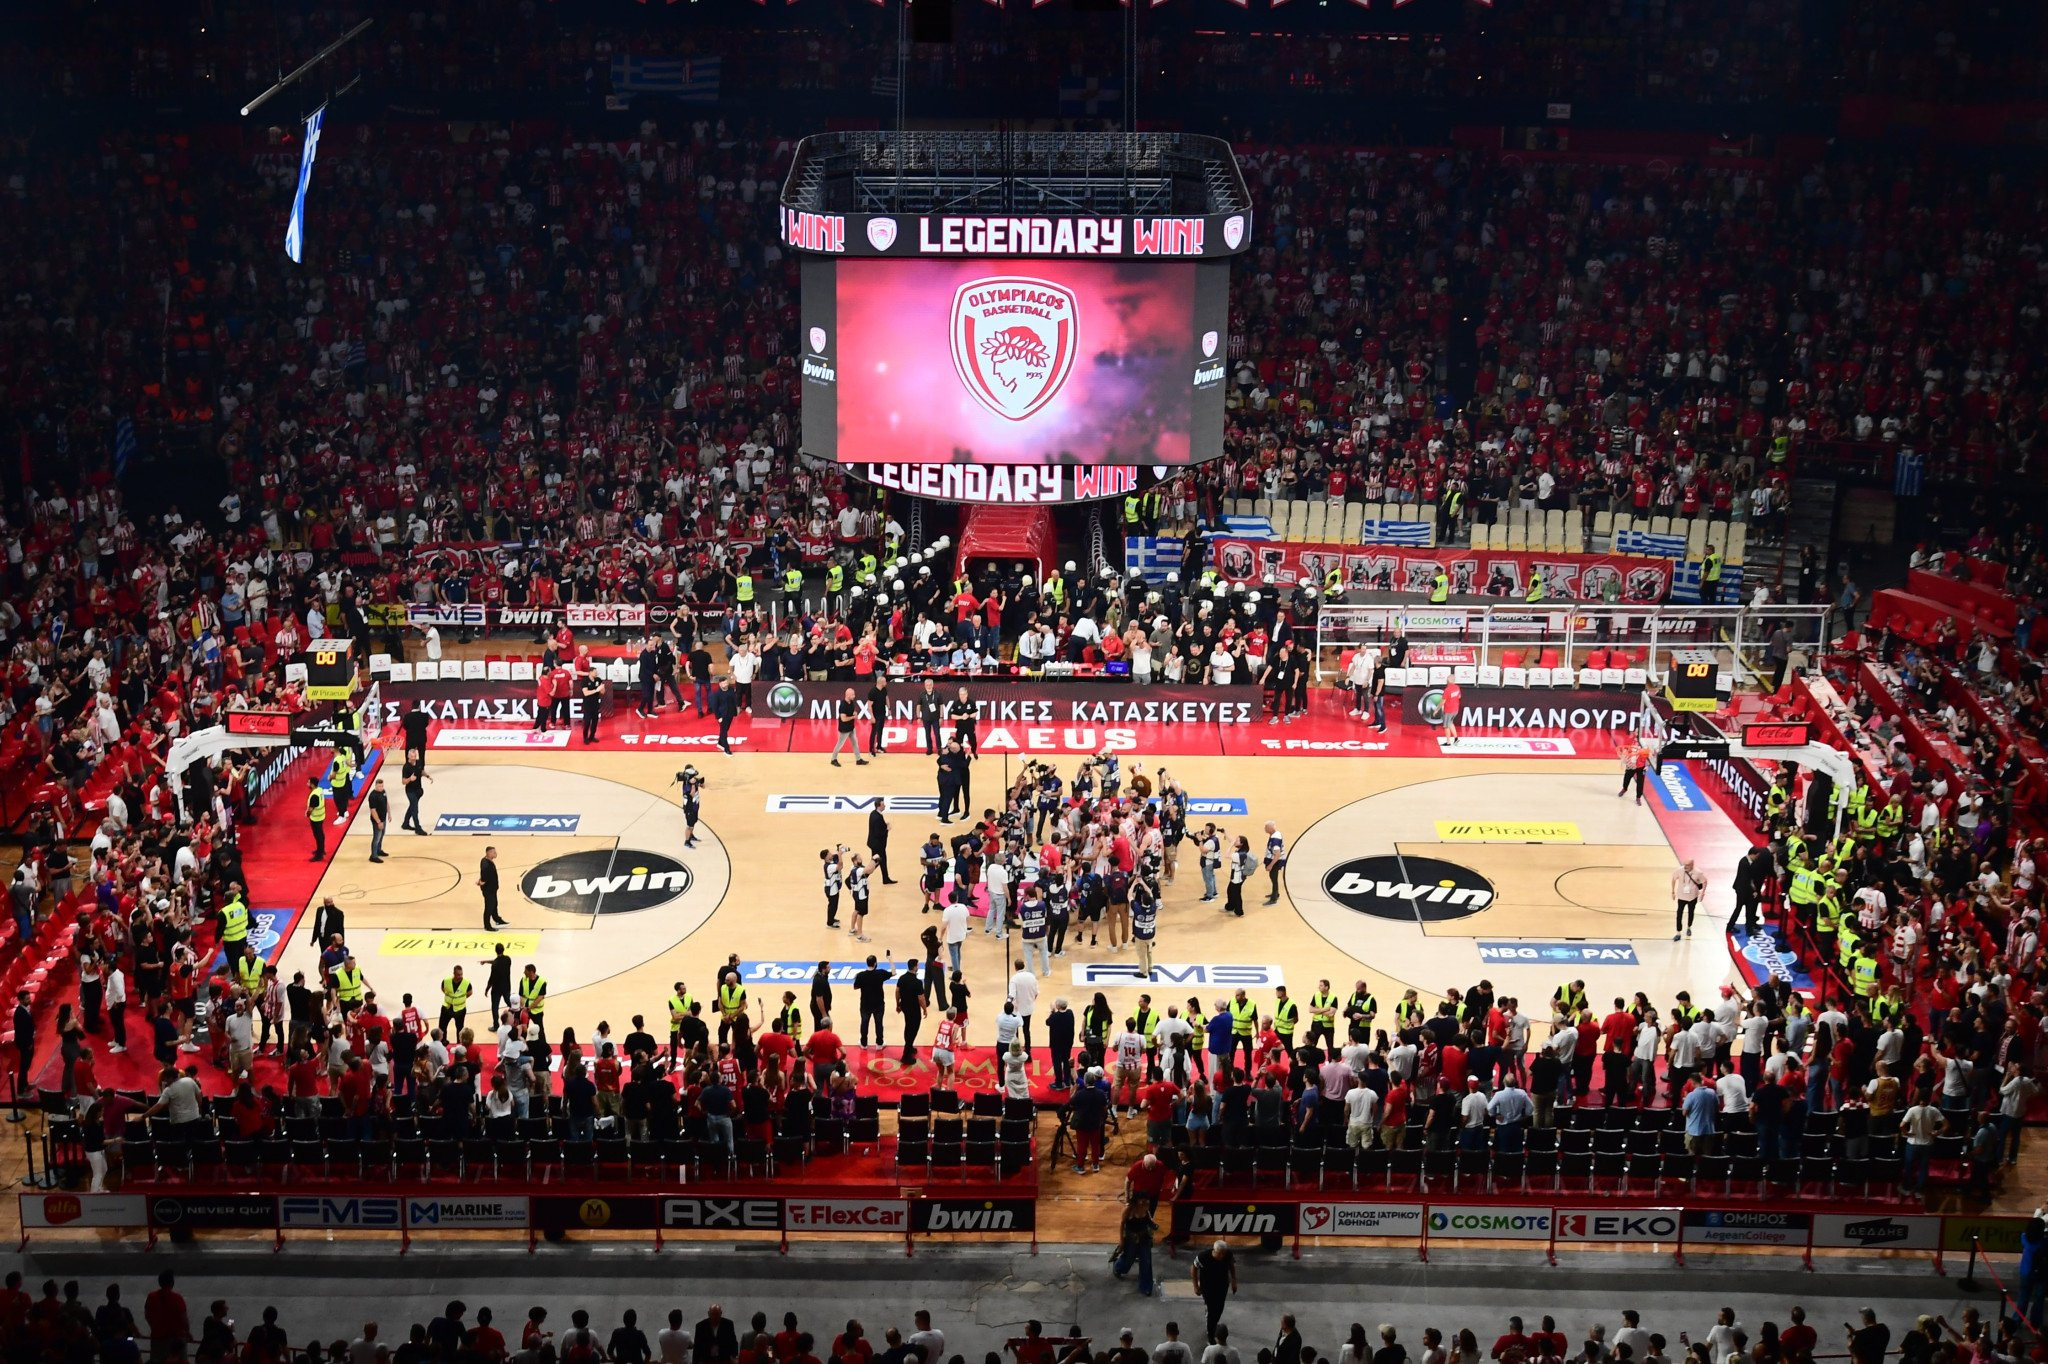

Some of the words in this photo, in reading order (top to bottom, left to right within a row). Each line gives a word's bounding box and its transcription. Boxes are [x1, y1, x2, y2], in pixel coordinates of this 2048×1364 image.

[788, 209, 845, 253] WIN!
[919, 217, 1123, 254] LEGENDARY
[1133, 218, 1205, 255] WIN!
[968, 288, 1066, 311] OLYMPIACOS
[982, 304, 1052, 321] BASKETBALL
[802, 359, 836, 382] bwin
[1193, 363, 1226, 386] bwin
[867, 462, 1063, 502] LEGENDARY
[500, 606, 553, 625] bwin
[1411, 616, 1462, 626] COSMOTE
[1072, 701, 1252, 723] ΚΑΤΑΣΚΕΥΕΣ
[313, 739, 336, 748] bwin
[1286, 738, 1389, 751] FlexCar
[778, 796, 940, 810] FMS
[438, 817, 487, 829] NBG
[530, 817, 580, 829] PAY
[1477, 822, 1570, 839] Piraeus
[530, 866, 688, 901] bwin
[1330, 872, 1494, 907] bwin
[1480, 945, 1537, 960] NBG
[1581, 946, 1634, 961] PAY
[1086, 964, 1269, 984] FMS
[186, 1206, 235, 1216] NEVER
[239, 1206, 273, 1216] QUIT
[283, 1198, 399, 1225] FMS
[440, 1203, 503, 1217] MARINE
[664, 1199, 778, 1227] AXE
[811, 1205, 904, 1226] FlexCar
[927, 1200, 1015, 1231] bwin
[1189, 1204, 1278, 1233] bwin
[1338, 1210, 1376, 1219] ΟΜΙΛΟΣ
[1377, 1211, 1420, 1220] ΙΑΤΡΙΚΟΥ
[1723, 1212, 1789, 1226] ΟΜΗΡΟΣ
[1338, 1218, 1380, 1227] ΑΘΗΝΩΝ
[1451, 1214, 1550, 1231] COSMOTE
[1594, 1216, 1676, 1237] EKO
